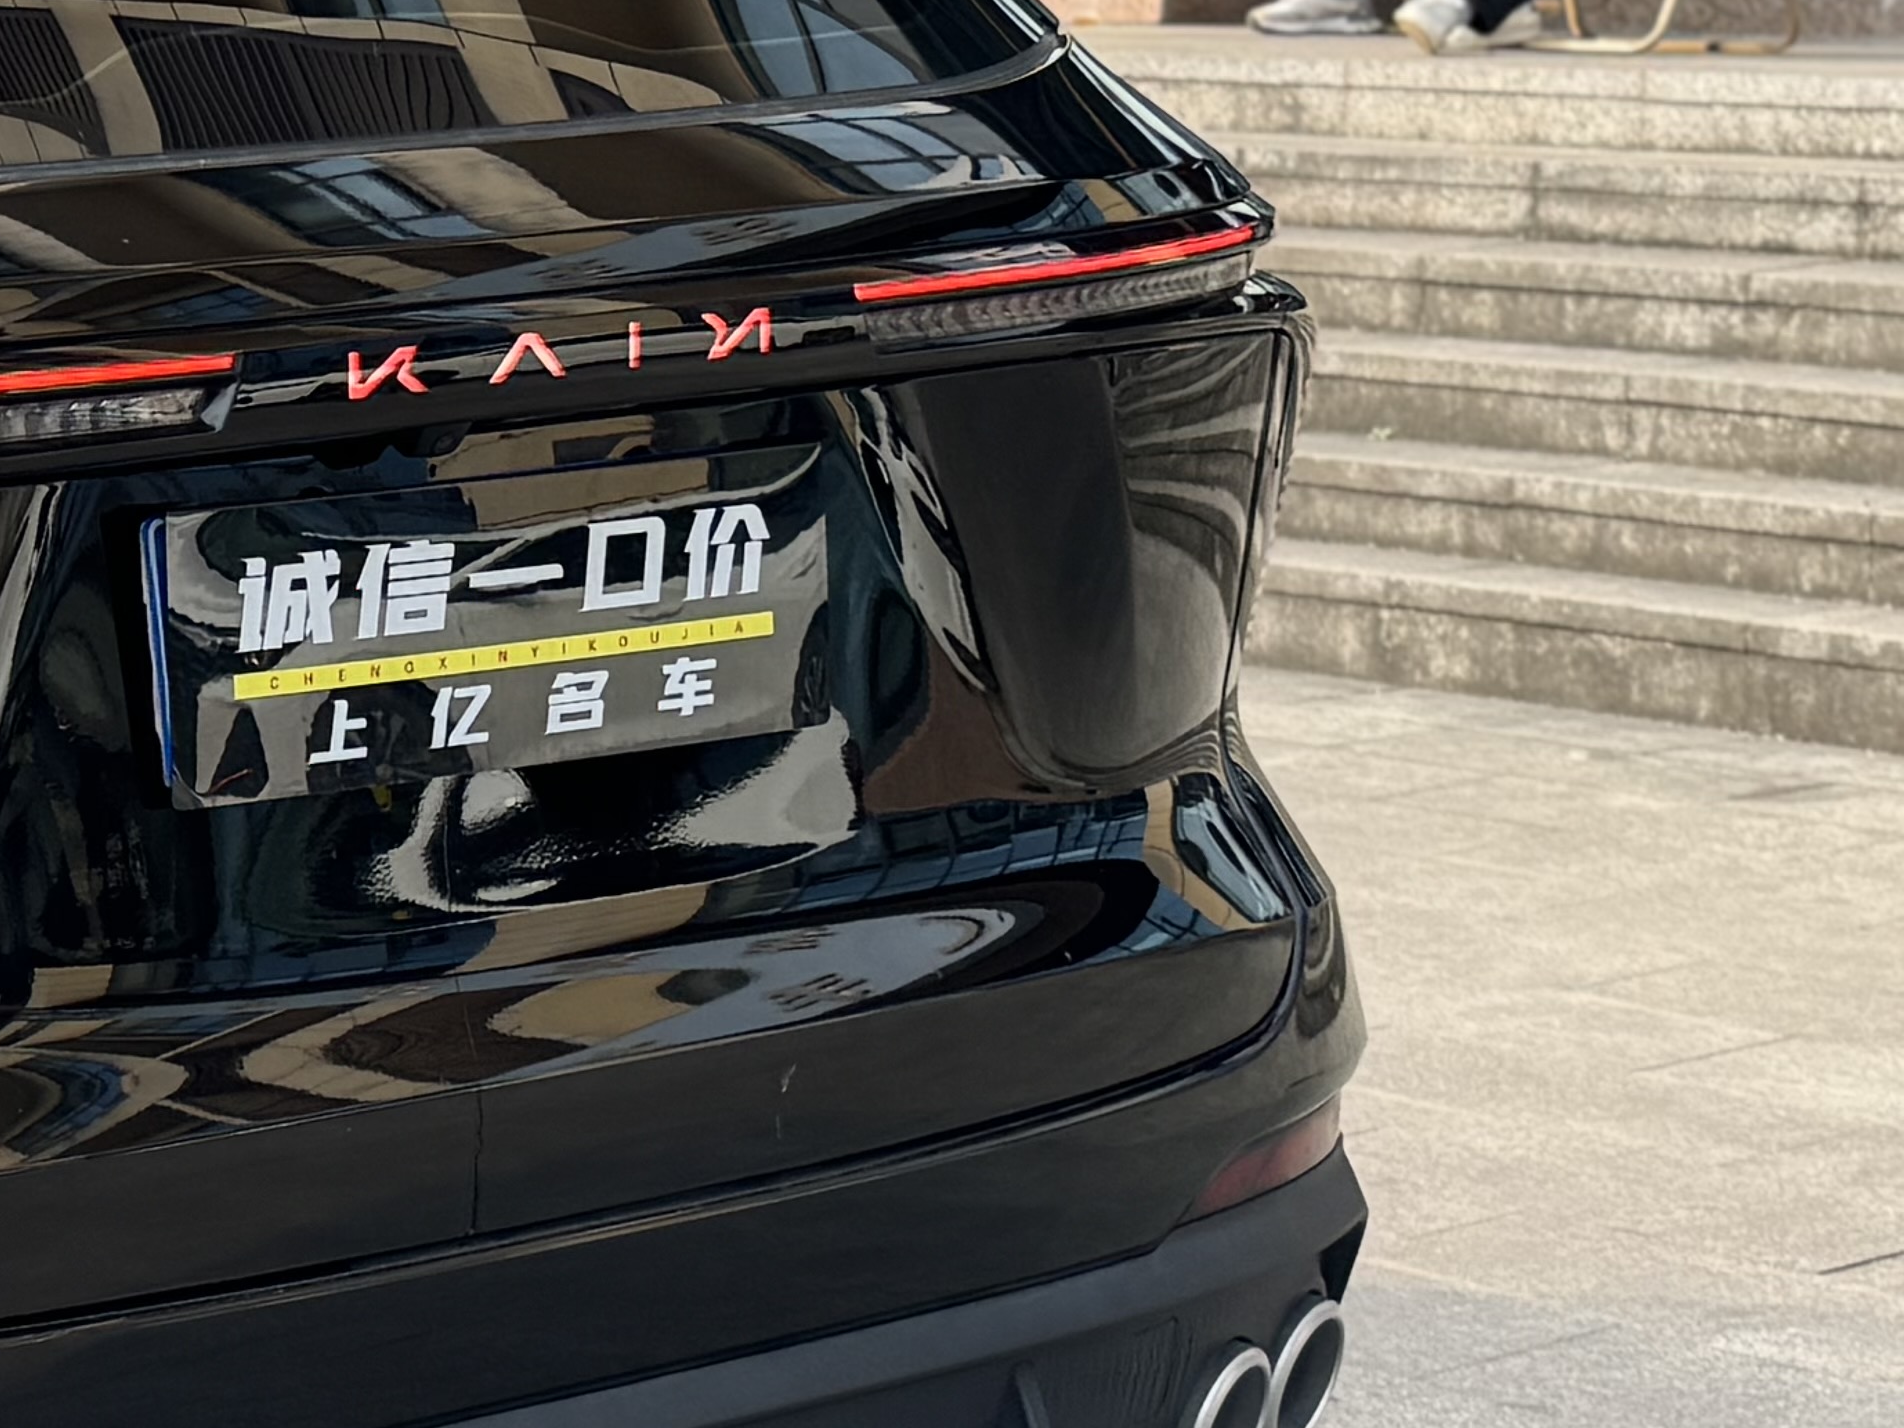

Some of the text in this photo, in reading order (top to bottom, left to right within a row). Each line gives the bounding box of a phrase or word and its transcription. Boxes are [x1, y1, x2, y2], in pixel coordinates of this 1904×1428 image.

[235, 502, 771, 653] 诚信一口价
[308, 655, 718, 766] 上亿名车
